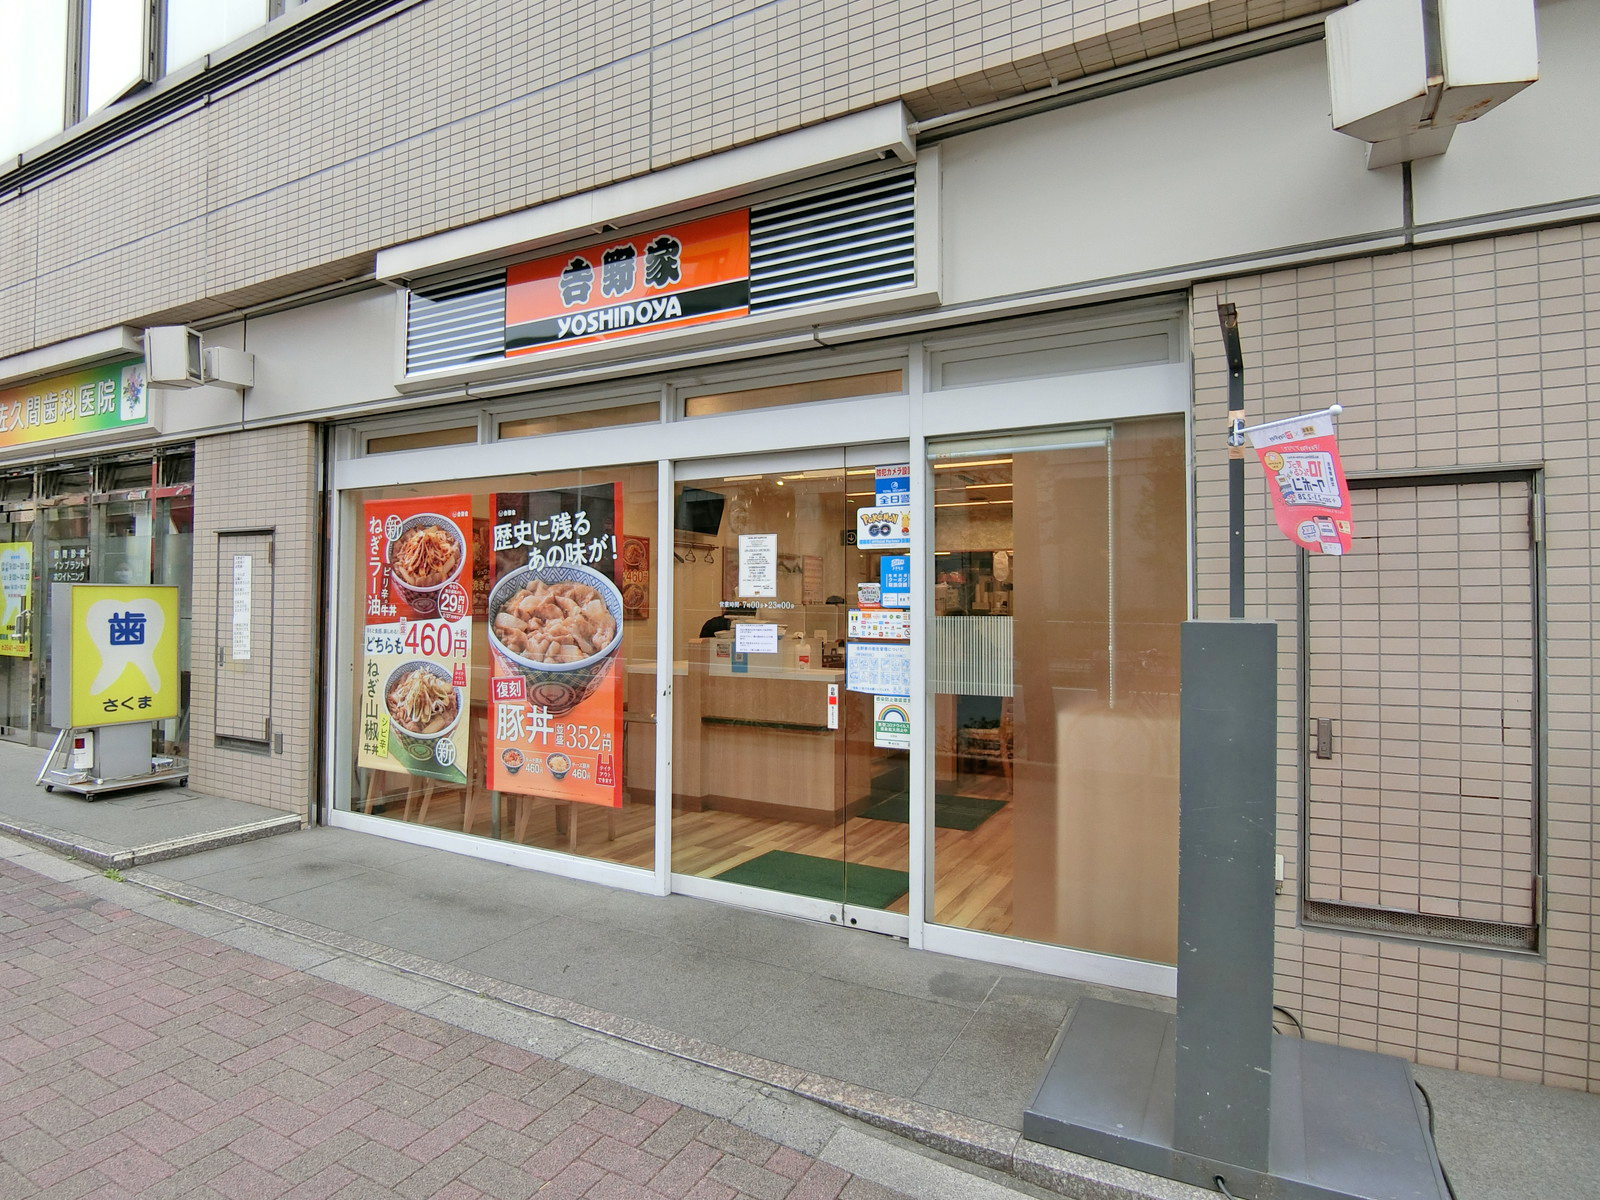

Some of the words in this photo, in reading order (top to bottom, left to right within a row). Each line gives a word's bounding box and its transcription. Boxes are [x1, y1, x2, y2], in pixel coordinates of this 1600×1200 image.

[557, 296, 682, 339] YOSHINOYA
[493, 510, 591, 552] 歴史に残る
[868, 524, 892, 537] GO
[528, 534, 618, 572] あの味が!
[54, 560, 86, 570] インプラント
[368, 516, 382, 616] ねぎラー油
[53, 572, 85, 581] ホワイトニング
[381, 605, 397, 616] 牛丼
[108, 611, 146, 646] 歯
[366, 636, 404, 655] どちらも
[404, 622, 453, 658] 460
[453, 639, 467, 658] 円
[496, 680, 522, 698] 復刻
[103, 696, 152, 712] さくま
[365, 659, 379, 741] ねぎ山椒
[496, 704, 554, 745] 豚丼
[566, 723, 600, 750] 352
[602, 739, 612, 752] 円
[364, 743, 379, 756] 牛丼
